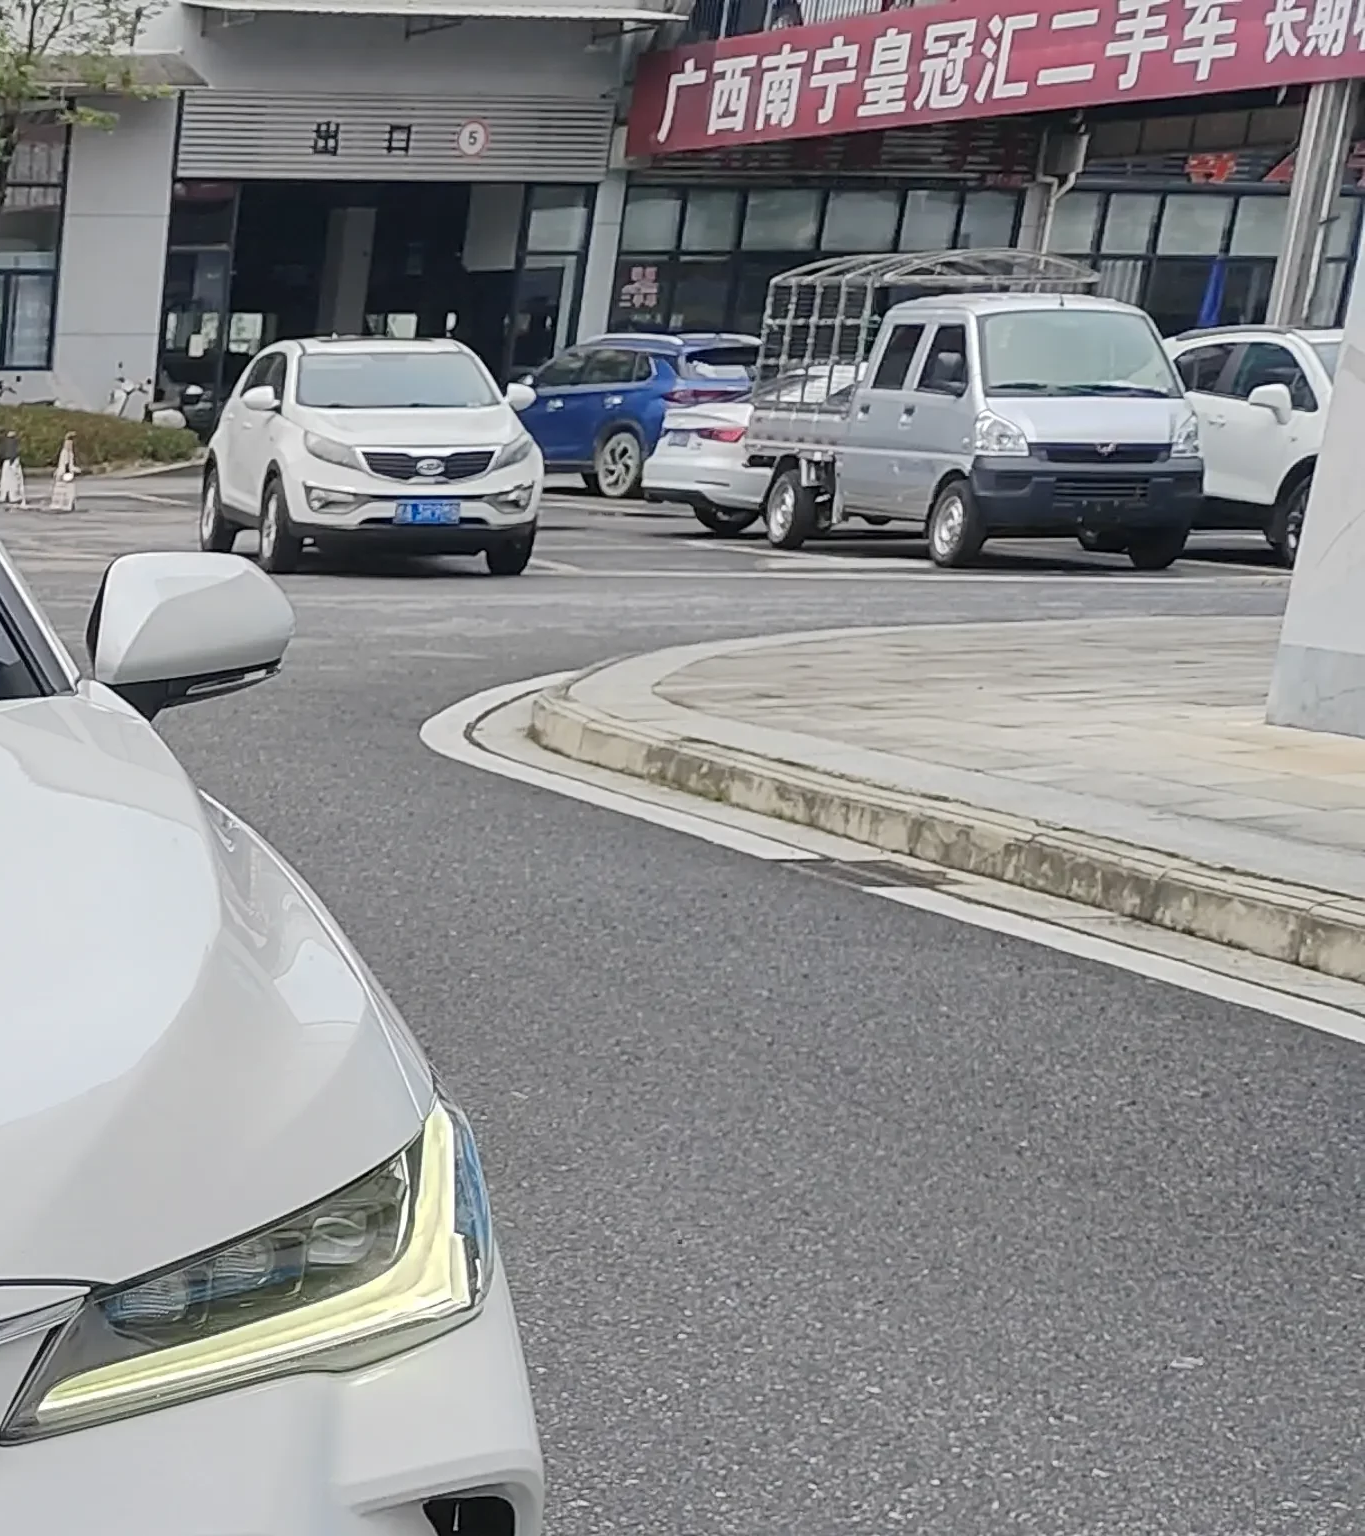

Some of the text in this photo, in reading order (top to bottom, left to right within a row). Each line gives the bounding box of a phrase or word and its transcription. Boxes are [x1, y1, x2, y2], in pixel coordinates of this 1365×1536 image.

[656, 0, 1238, 143] 广西南宁皇冠汇二手车
[312, 120, 413, 156] 出口
